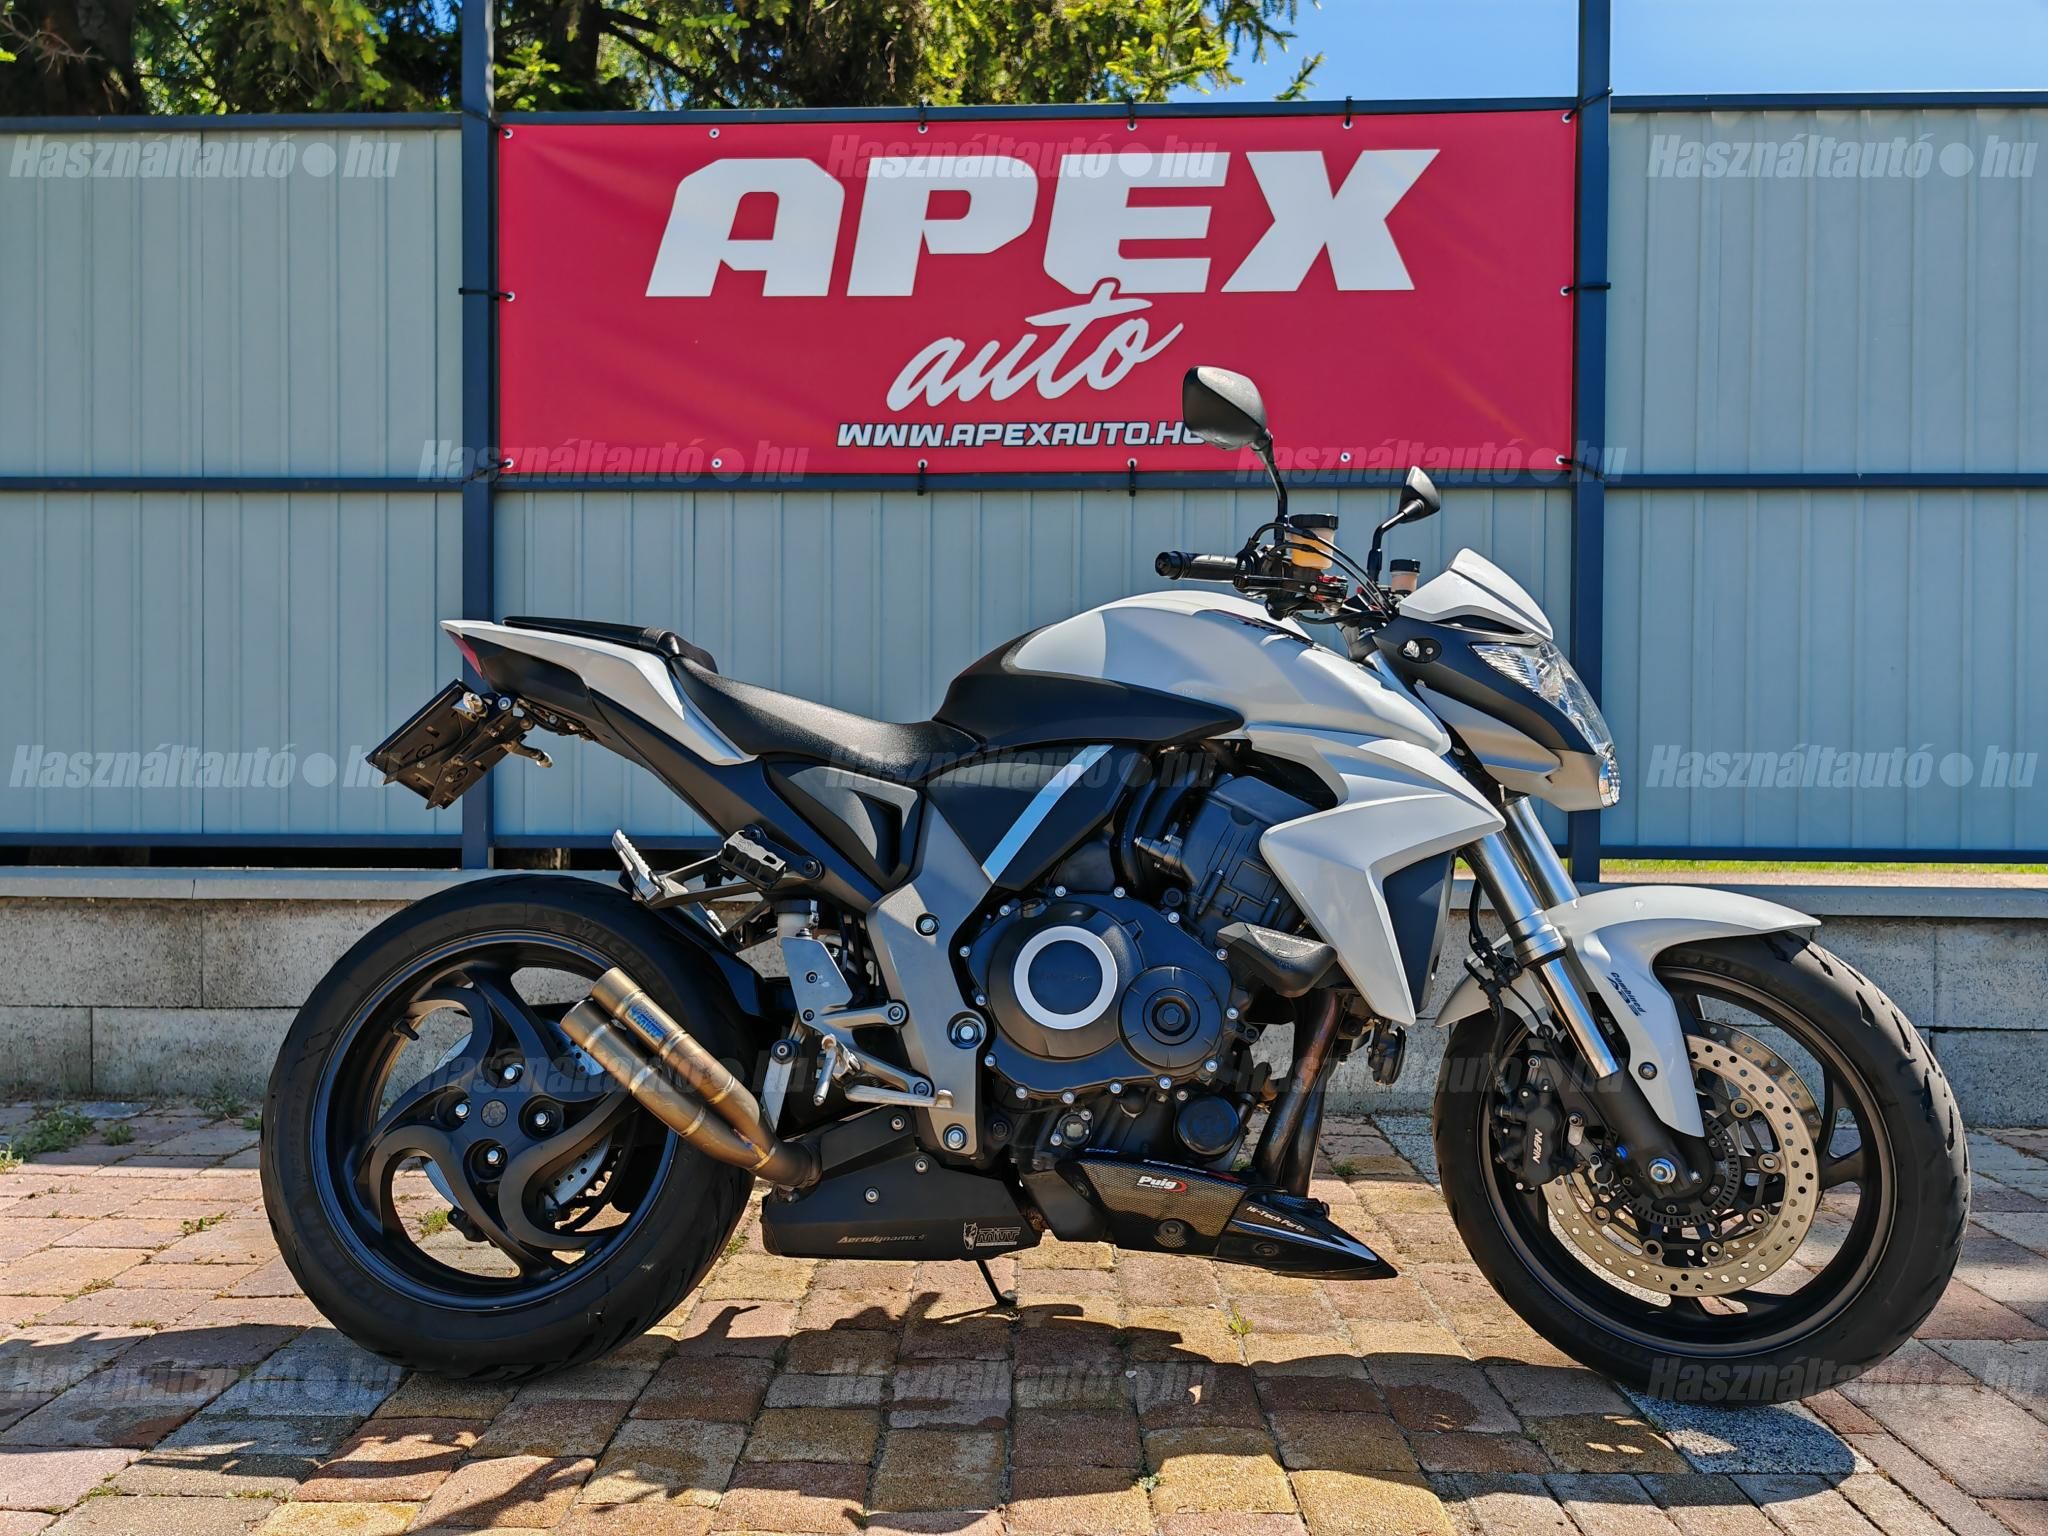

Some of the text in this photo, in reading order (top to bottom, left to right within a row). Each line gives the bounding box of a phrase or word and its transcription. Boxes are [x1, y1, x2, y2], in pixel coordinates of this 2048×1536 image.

[645, 148, 1441, 298] APEX
[886, 281, 1184, 412] auto
[1138, 1175, 1178, 1190] Puig
[1246, 1205, 1307, 1231] Hi-Tech Parts
